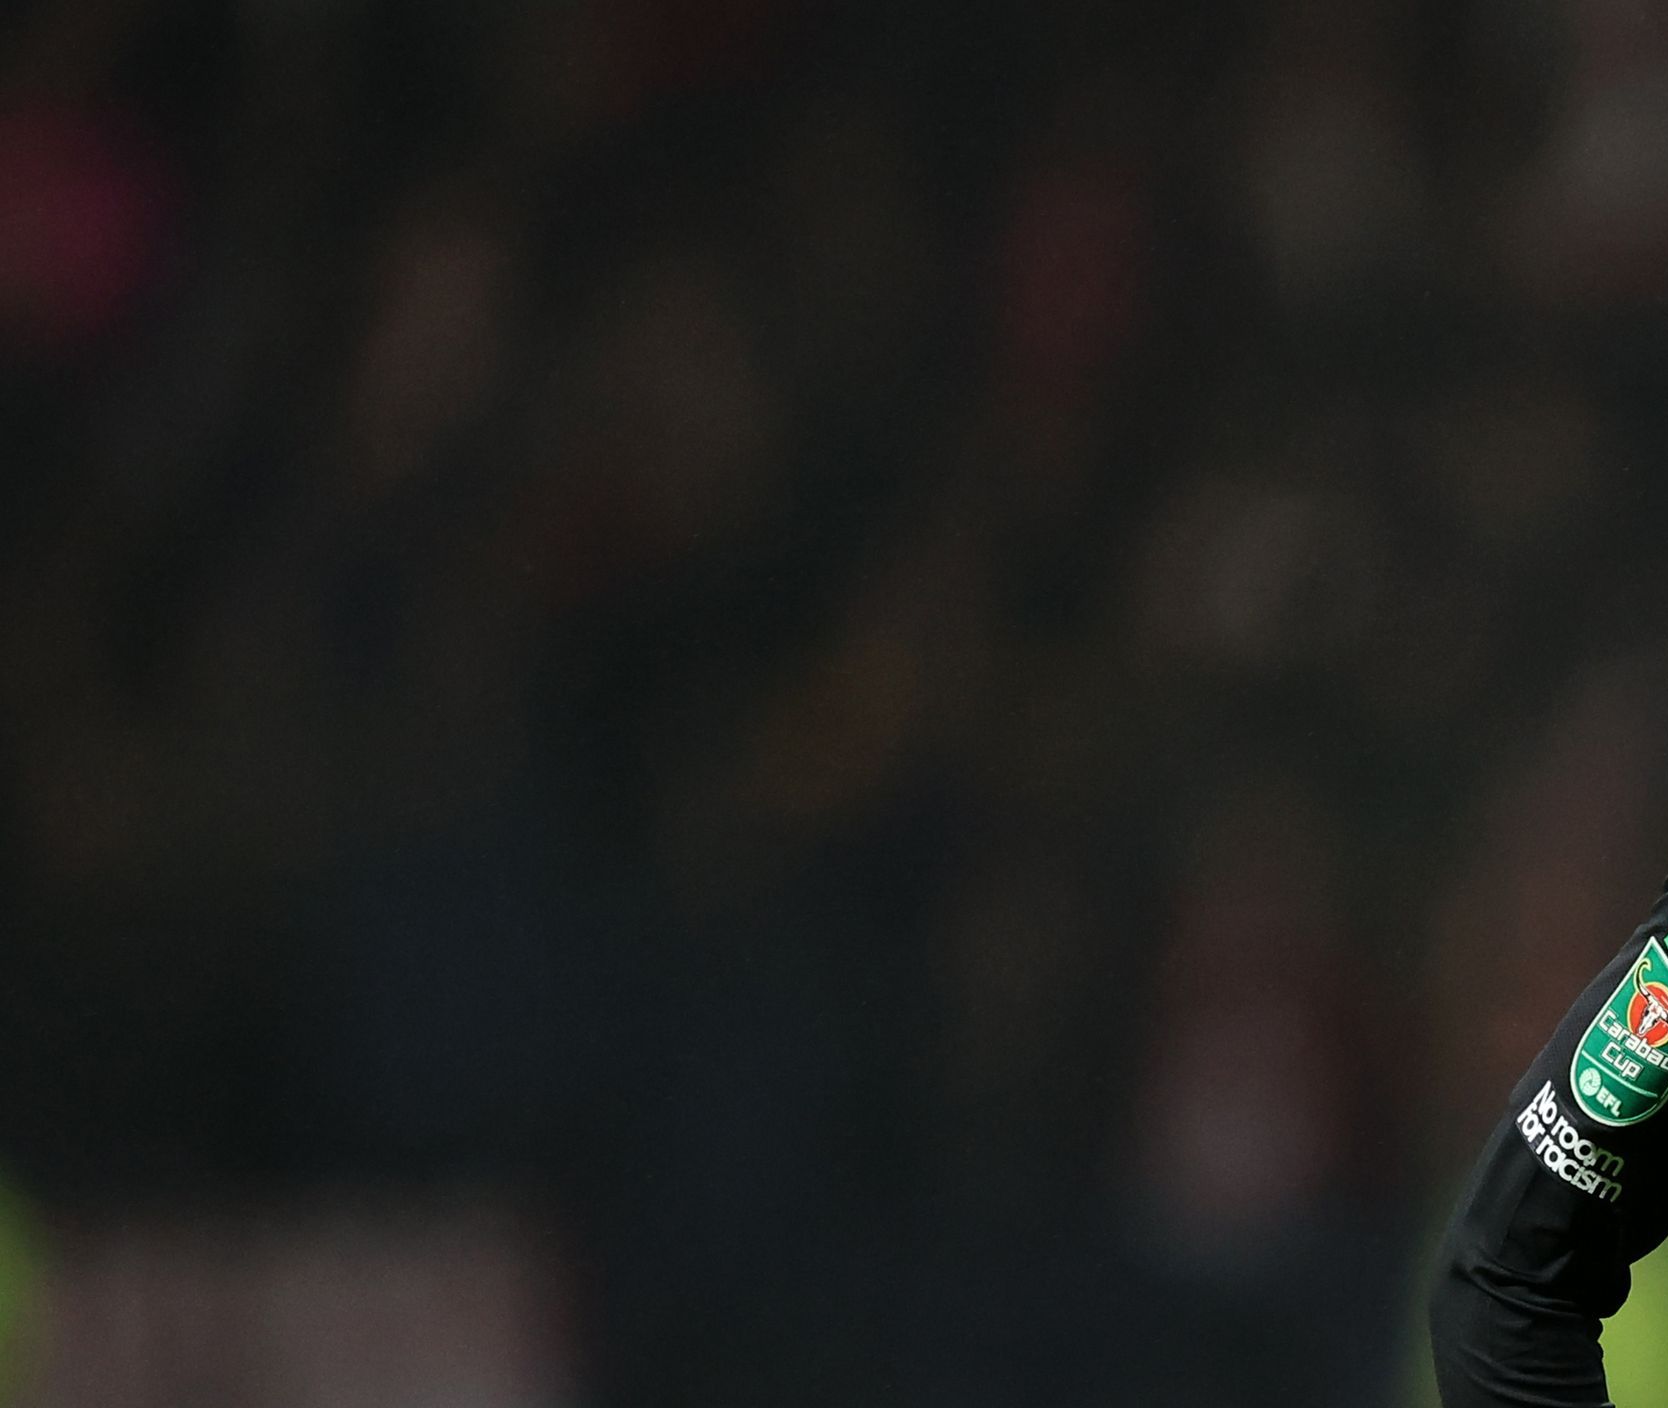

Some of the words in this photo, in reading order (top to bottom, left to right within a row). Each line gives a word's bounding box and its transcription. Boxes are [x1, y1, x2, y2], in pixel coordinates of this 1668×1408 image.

[1601, 1041, 1642, 1079] Cup
[1533, 1079, 1558, 1125] No
[1551, 1115, 1625, 1177] room
[1596, 1086, 1622, 1118] EFL
[1517, 1102, 1546, 1143] for
[1535, 1134, 1623, 1203] racism
